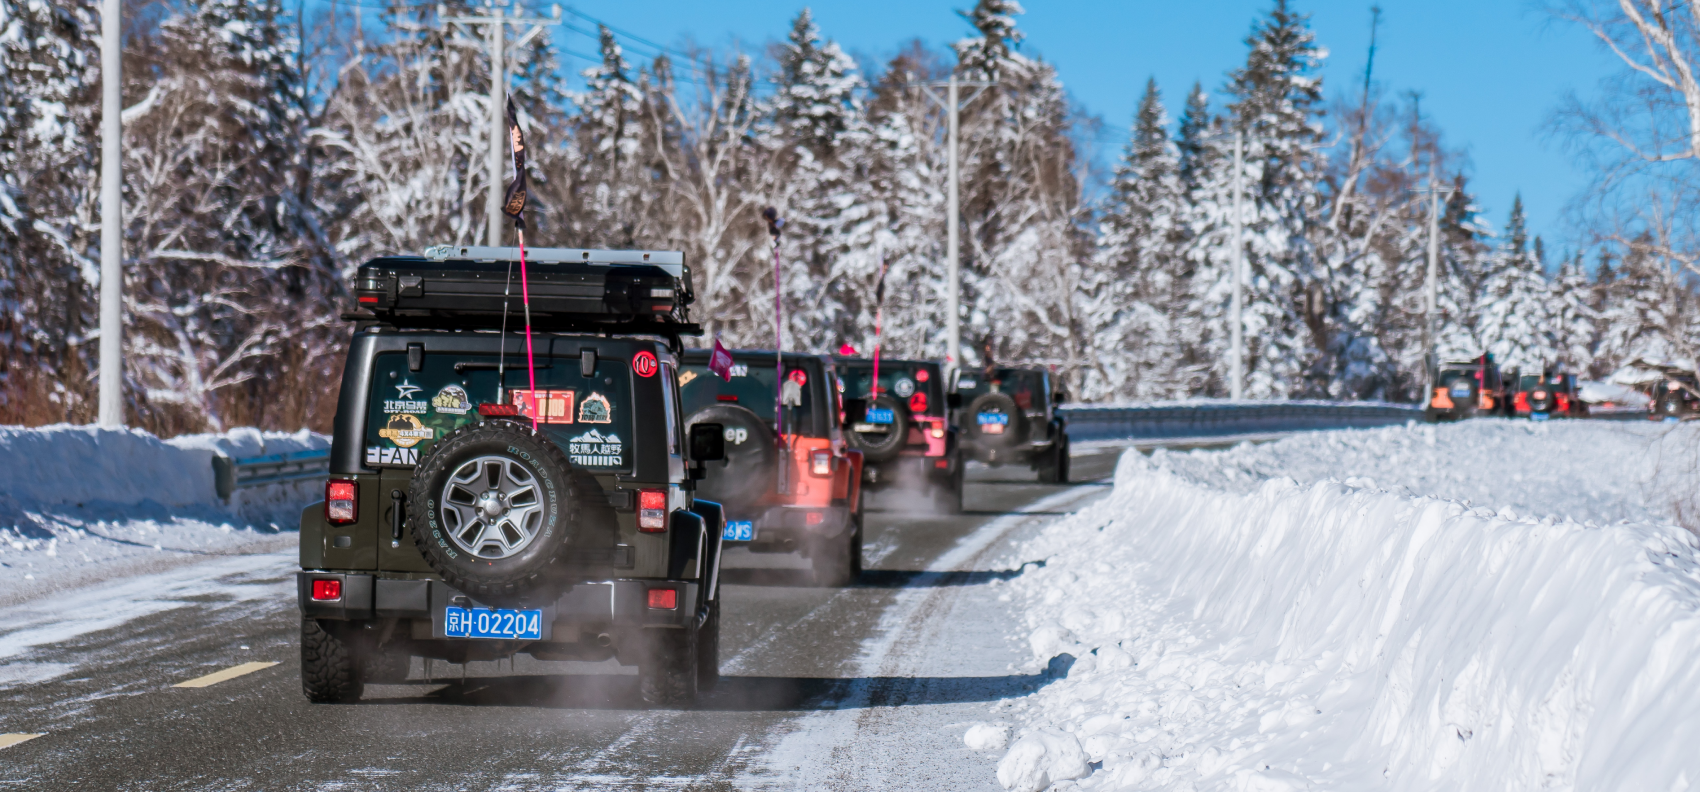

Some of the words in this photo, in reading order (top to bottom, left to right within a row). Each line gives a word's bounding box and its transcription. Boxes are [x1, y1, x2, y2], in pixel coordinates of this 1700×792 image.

[724, 427, 748, 445] ep
[507, 445, 558, 538] ROADCRUZA
[427, 499, 458, 560] RA3200
